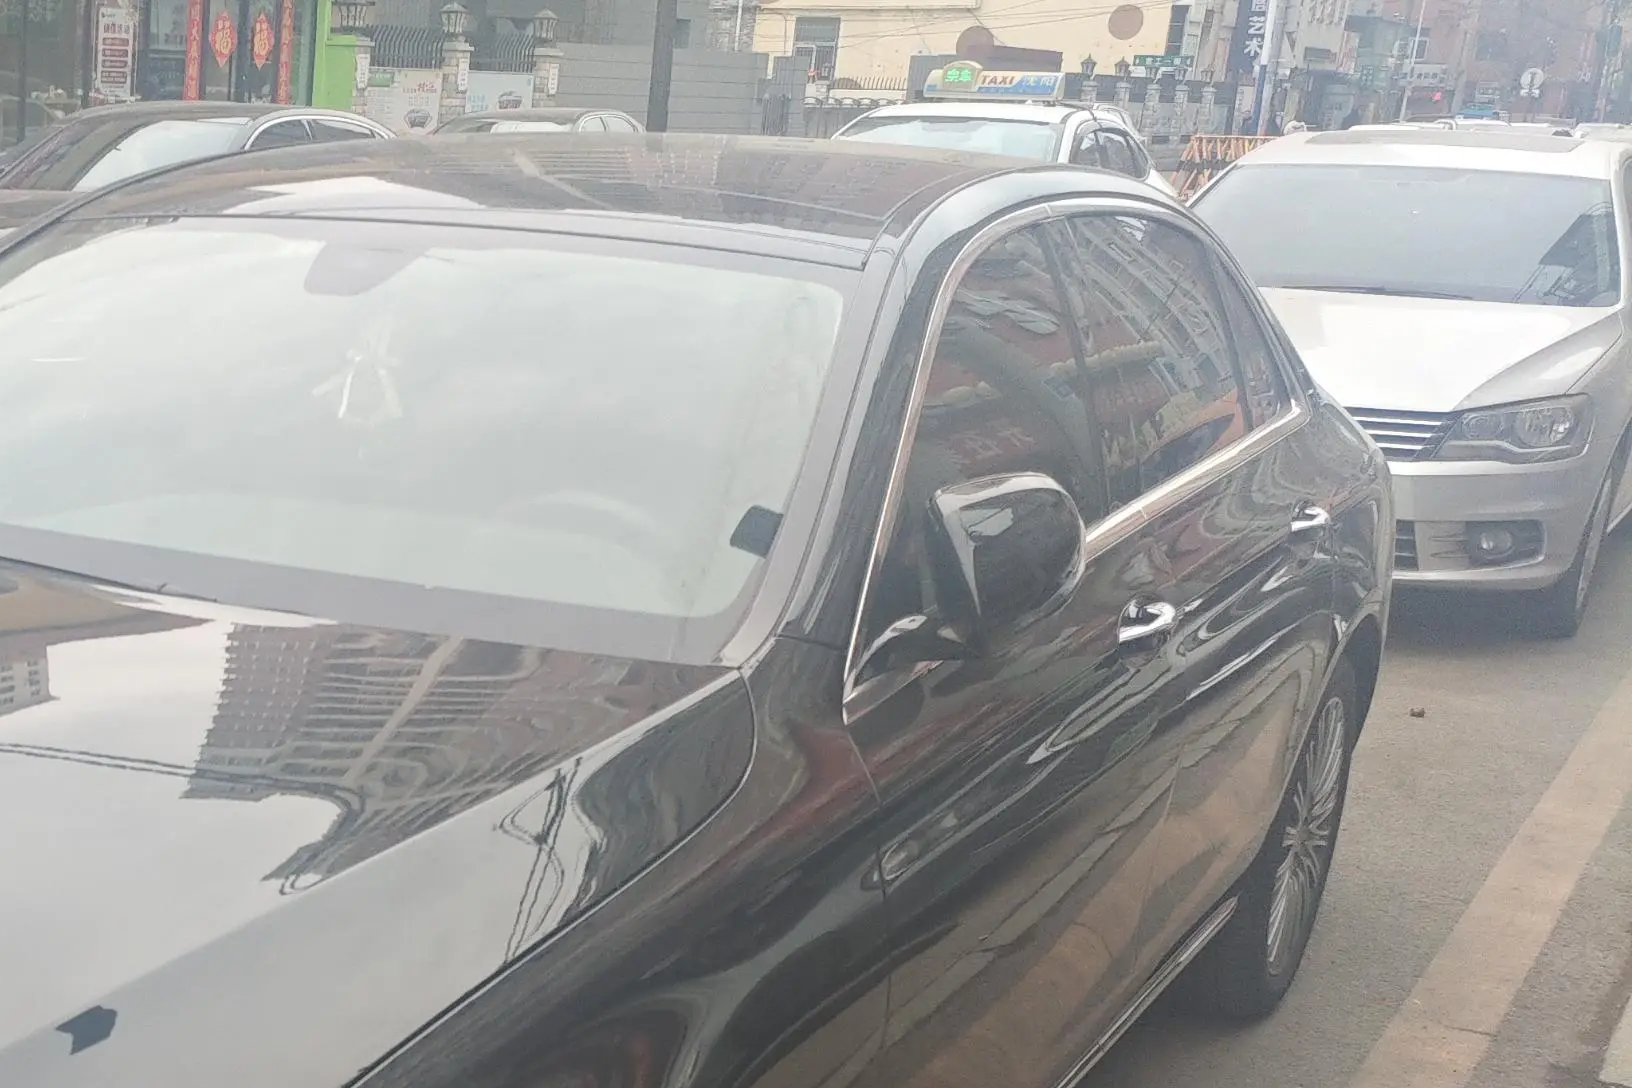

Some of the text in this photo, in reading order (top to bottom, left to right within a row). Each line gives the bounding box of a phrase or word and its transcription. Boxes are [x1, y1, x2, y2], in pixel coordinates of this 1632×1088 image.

[214, 19, 232, 54] 福
[253, 20, 269, 55] 福
[981, 75, 1016, 86] TAXI
